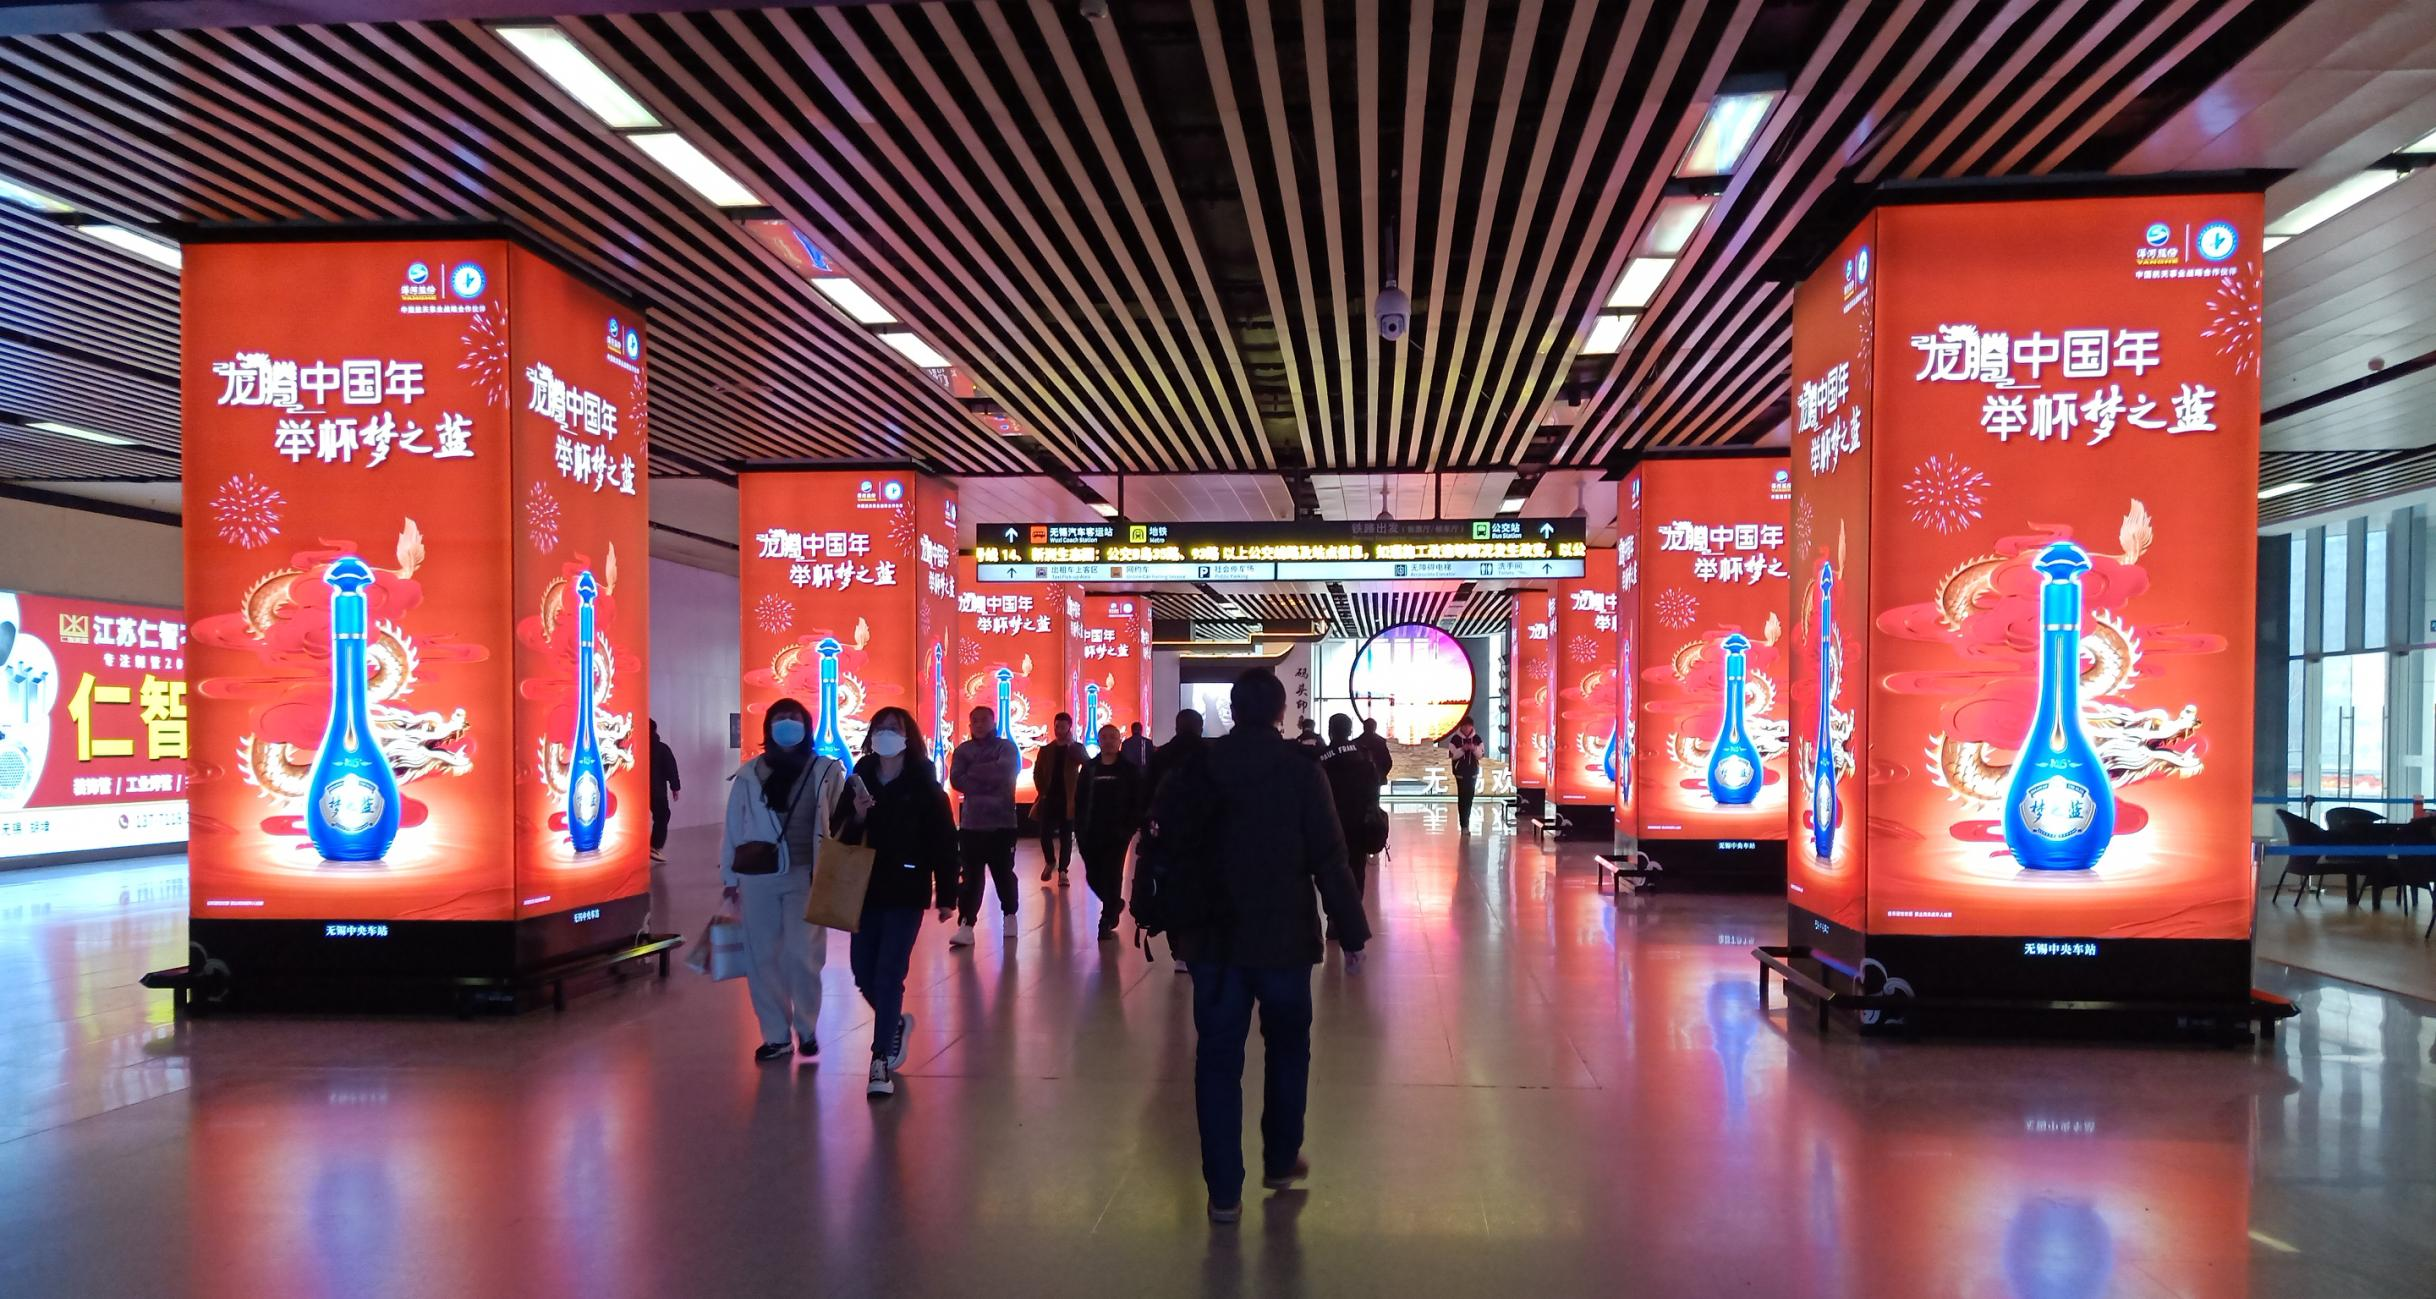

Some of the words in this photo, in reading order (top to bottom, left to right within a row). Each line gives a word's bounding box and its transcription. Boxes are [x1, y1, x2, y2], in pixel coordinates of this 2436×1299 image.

[1911, 323, 2161, 390] 龙腾中国年
[212, 352, 426, 414] 龙腾中国年
[525, 361, 619, 440] 龙腾中国年
[1797, 361, 1850, 434] 龙腾中国年
[1981, 382, 2218, 446] 举杯梦之蓝
[274, 411, 475, 468] 举杯梦之蓝
[1809, 405, 1862, 478] 举杯梦之蓝
[554, 434, 637, 496] 举杯梦之蓝
[1049, 527, 1113, 537] 无锡汽车客运站
[1149, 526, 1168, 537] 地铁
[1492, 522, 1520, 533] 公交站
[1658, 520, 1785, 556] 龙腾中国年
[756, 528, 870, 562] 龙腾中国年
[789, 560, 897, 591] 举杯梦之蓝
[1051, 566, 1098, 574] 出租车上客区
[1126, 566, 1148, 574] 网约车
[1215, 565, 1255, 573] 社会停车场
[1411, 563, 1452, 571] 无障碍电梯
[1498, 562, 1523, 570] 洗手间
[1693, 553, 1792, 586] 举杯梦之
[958, 592, 1034, 616] 龙腾中国年
[977, 614, 1052, 637] 举杯梦之蓝
[67, 671, 189, 761] 仁智
[1320, 750, 1336, 761] PAUL
[1338, 744, 1357, 754] FRANK
[325, 924, 388, 937] 无锡中央车站
[2023, 942, 2097, 957] 无锡中央车站
